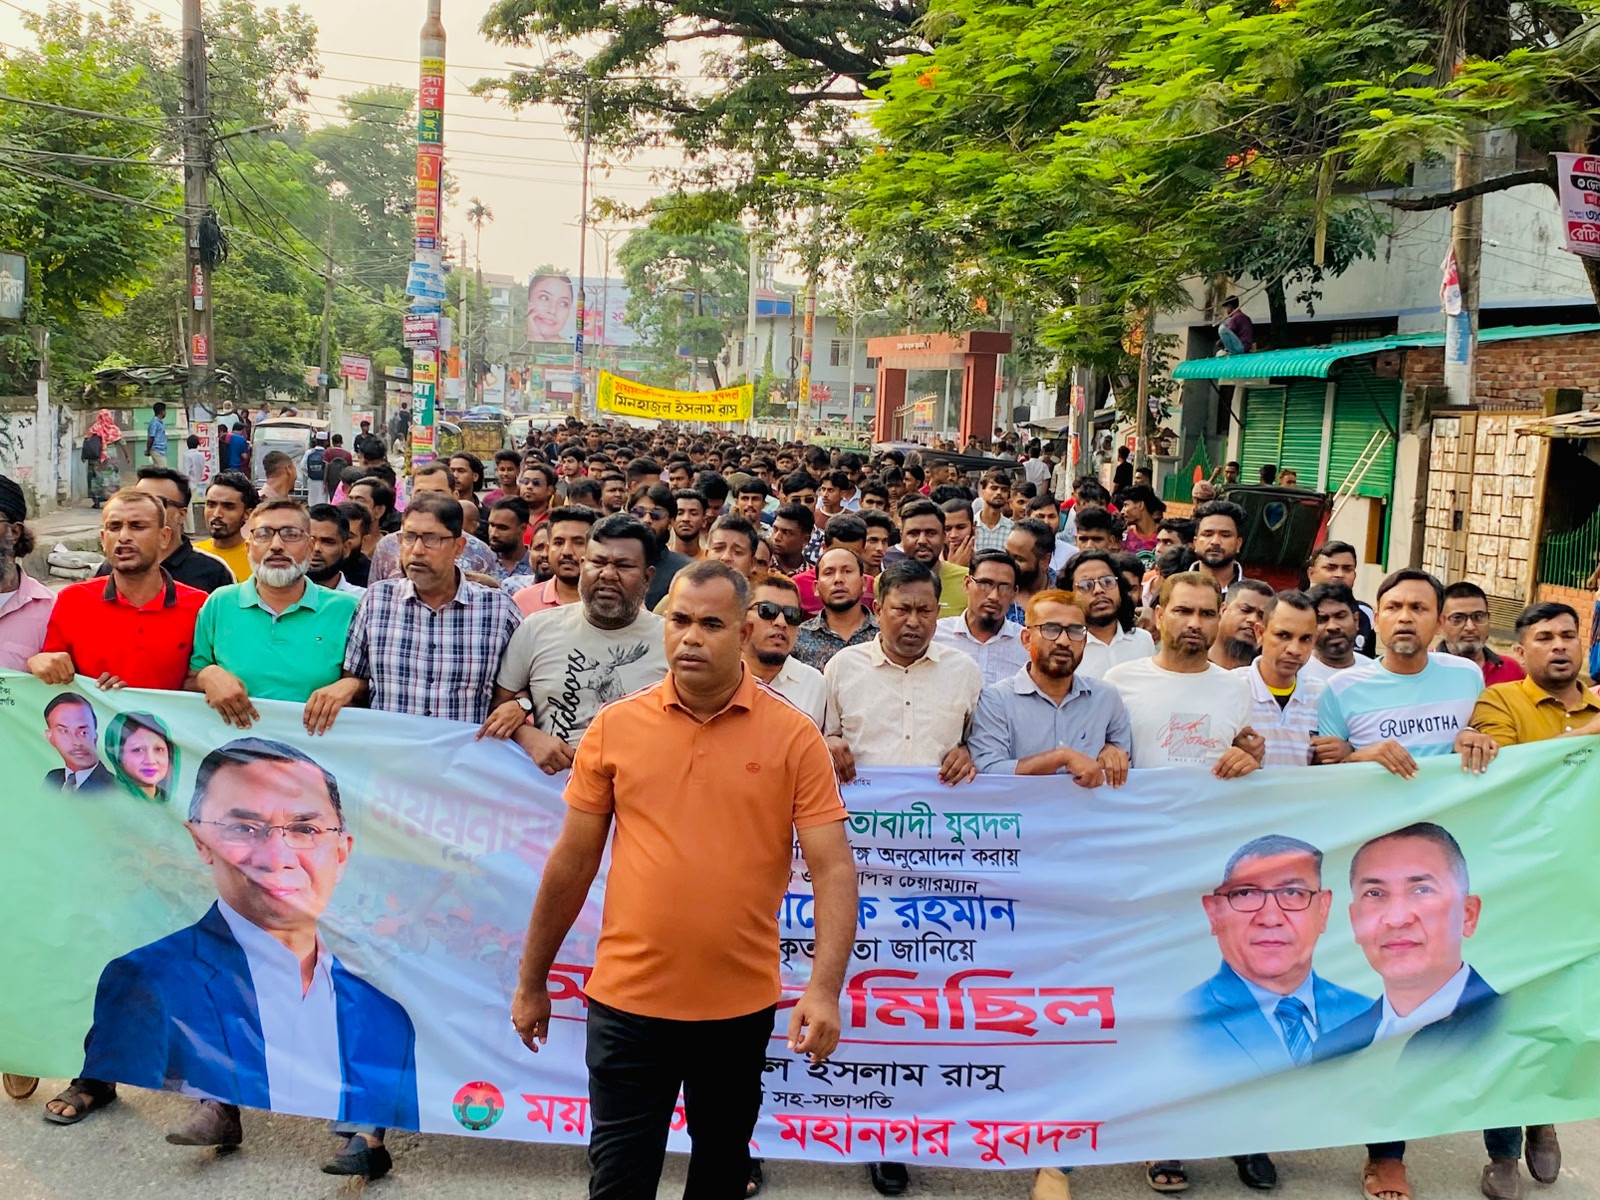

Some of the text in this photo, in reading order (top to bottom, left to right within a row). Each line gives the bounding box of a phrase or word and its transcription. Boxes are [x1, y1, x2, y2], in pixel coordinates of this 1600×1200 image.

[614, 393, 738, 417] মিনহাজুল ইসলাম রাসু
[1379, 714, 1459, 738] RUPKOTHA
[943, 812, 1023, 846] যুবদল
[877, 847, 965, 871] অনুমোদন
[971, 847, 1021, 867] করায়
[899, 873, 981, 894] চেয়ারম্যান
[888, 894, 1021, 932] রহমান
[888, 931, 977, 963] জানিয়ে
[845, 968, 1116, 1037] মিছিল
[939, 1060, 1006, 1092] রাসু
[772, 1090, 896, 1109] সহ-সভাপতি
[772, 1111, 956, 1157] মহানগর
[966, 1119, 1106, 1166] যুবদল
